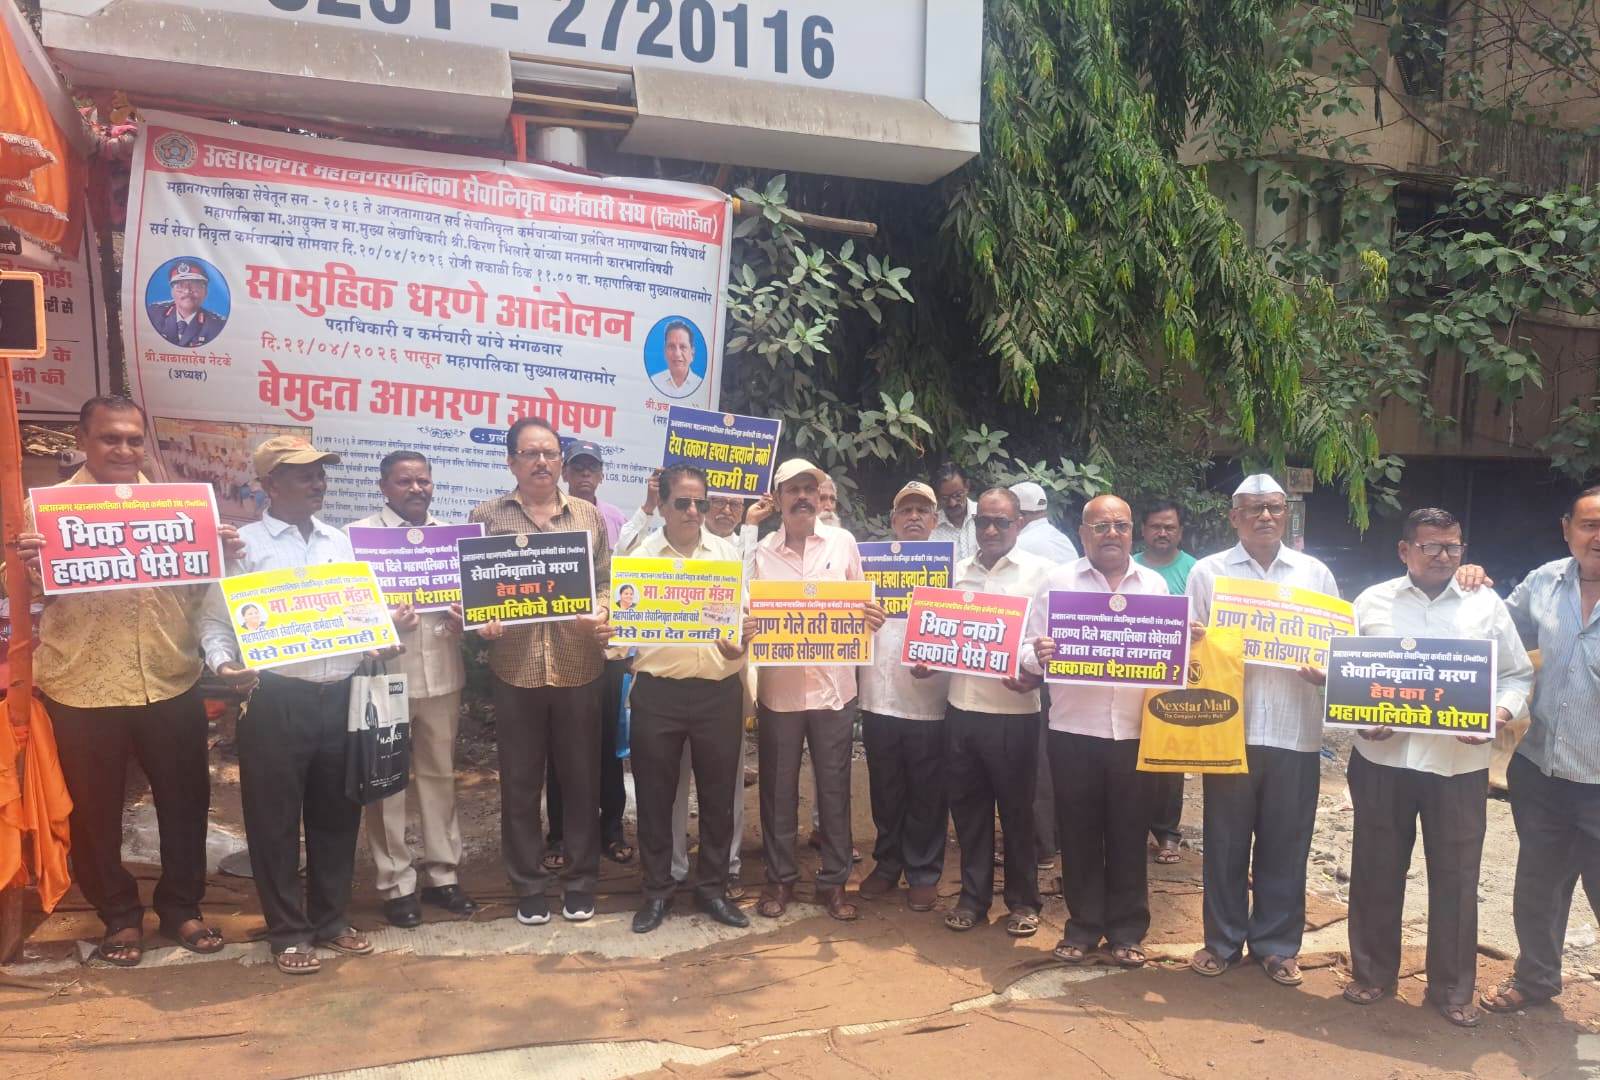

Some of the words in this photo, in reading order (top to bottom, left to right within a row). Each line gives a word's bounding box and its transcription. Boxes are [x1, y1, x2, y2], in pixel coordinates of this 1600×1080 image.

[490, 3, 519, 21] -
[548, 0, 835, 80] 2720116
[203, 144, 307, 176] उल्हासनगर
[313, 165, 458, 197] महानगरपालिका
[549, 190, 614, 220] कर्मचारी
[619, 195, 646, 224] संघ
[650, 205, 718, 239] (नियोजित)
[290, 194, 309, 206] सन
[245, 261, 398, 318] सामुहिक
[406, 279, 488, 323] धरणे
[495, 285, 635, 342] आंदोलन
[258, 360, 361, 422] बेमुदत
[369, 378, 500, 425] आमरण
[669, 430, 682, 455] देय
[755, 443, 771, 467] नको
[57, 516, 125, 549] भिक
[129, 512, 195, 543] नको
[51, 548, 137, 584] हक्काचे
[139, 545, 179, 578] पैसे
[548, 561, 579, 574] मरण
[496, 580, 517, 597] हेच
[519, 582, 541, 594] का
[547, 580, 555, 593] ?
[465, 596, 548, 622] महापालिकेचे
[551, 595, 591, 614] धोरण
[615, 625, 637, 639] पैसे
[641, 628, 661, 639] का
[664, 626, 684, 639] देत
[687, 627, 721, 640] नाही
[783, 612, 805, 635] गेले
[808, 612, 828, 635] तरी
[920, 610, 961, 638] भिक
[962, 617, 1006, 644] नको
[1082, 625, 1098, 640] दिले
[1099, 628, 1147, 644] महापालिका
[1149, 629, 1182, 645] सेवेसाठी
[1216, 609, 1248, 629] प्राण
[1251, 609, 1277, 633] गेले
[1279, 615, 1304, 637] तरी
[248, 645, 278, 661] पैसे
[283, 641, 306, 655] का
[310, 637, 334, 650] देत
[335, 628, 375, 644] नाही
[752, 643, 769, 660] पण
[772, 643, 795, 660] हक्क
[797, 637, 835, 660] सोडणार
[837, 638, 861, 660] नाही
[908, 640, 959, 665] हक्काचे
[962, 641, 987, 670] पैसे
[1059, 644, 1089, 656] आता
[1264, 637, 1311, 664] सोडणार
[1106, 658, 1168, 680] पैशासाठी
[1172, 665, 1181, 681] ?
[1439, 669, 1477, 683] मरण
[1156, 697, 1201, 712] Nexstar
[1203, 698, 1231, 712] Mall
[1370, 682, 1396, 699] हेच
[1399, 687, 1427, 701] का
[1433, 688, 1445, 702] ?
[1328, 701, 1432, 726] महापालिकेचे
[1437, 706, 1489, 730] धोरण
